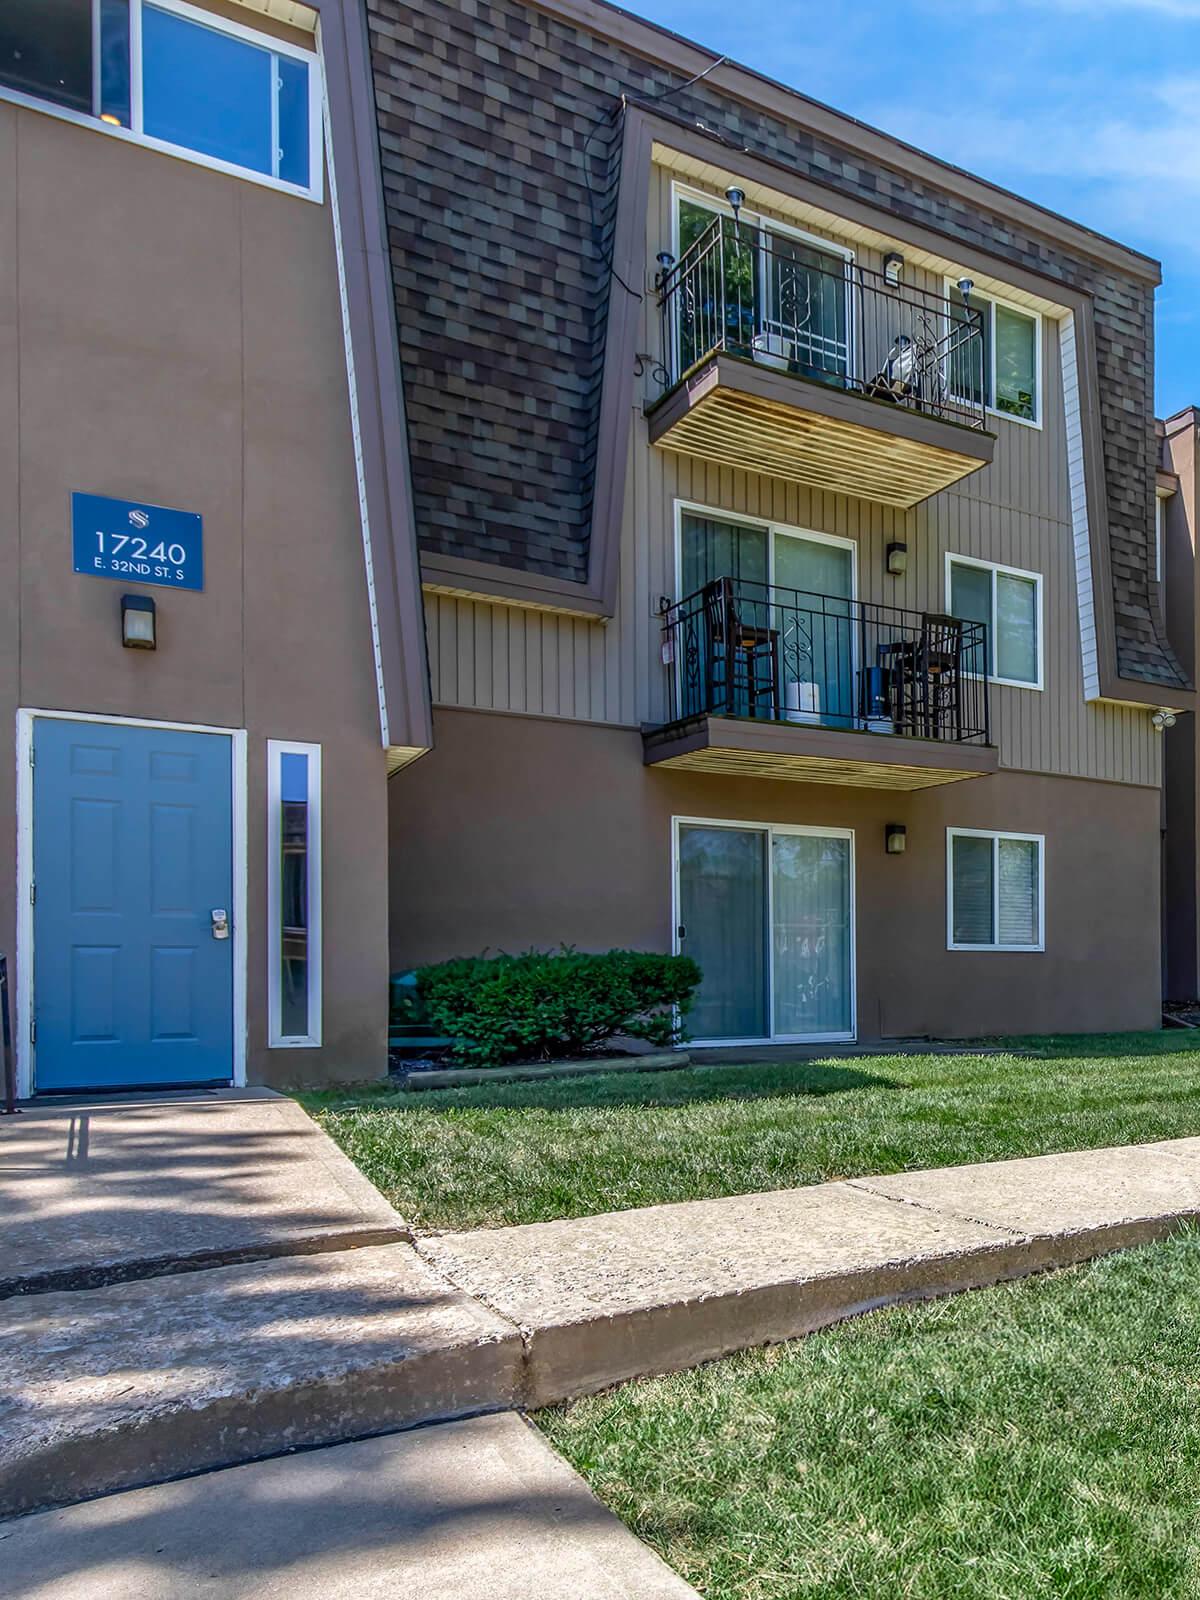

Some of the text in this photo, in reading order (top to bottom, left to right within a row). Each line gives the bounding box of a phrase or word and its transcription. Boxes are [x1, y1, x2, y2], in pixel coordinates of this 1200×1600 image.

[95, 531, 186, 565] 17240
[94, 556, 185, 580] E. 32ND ST. S
